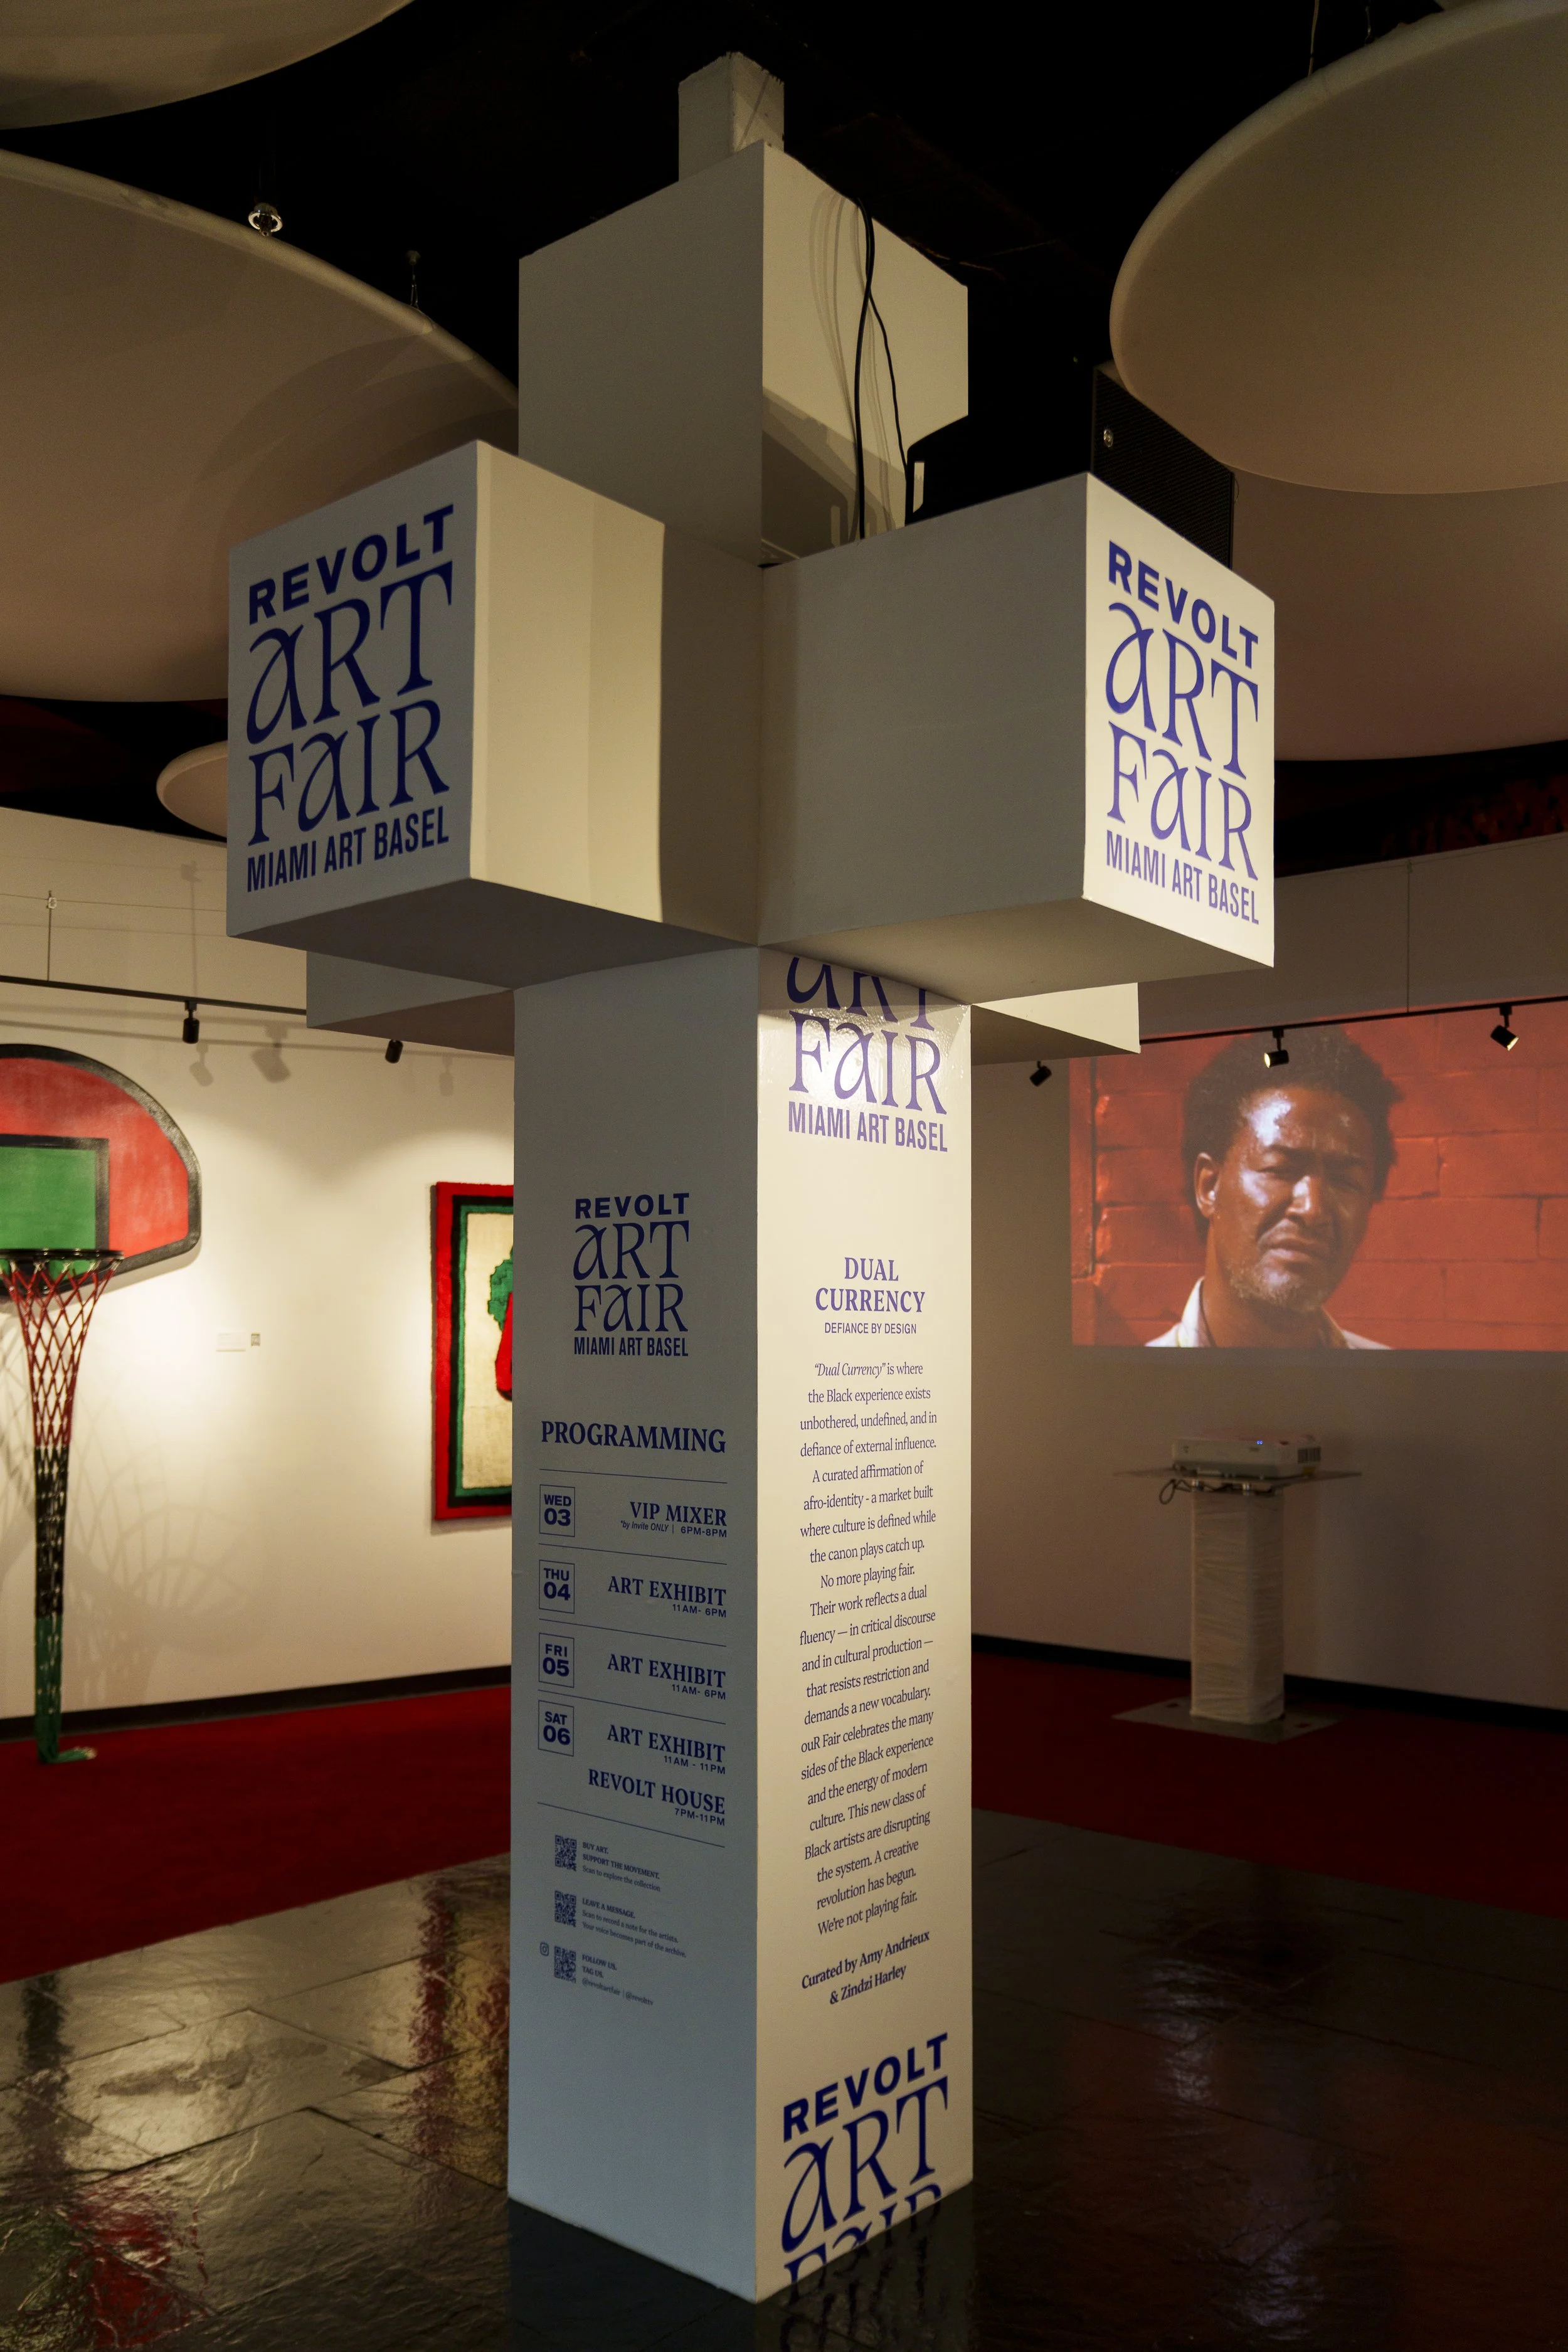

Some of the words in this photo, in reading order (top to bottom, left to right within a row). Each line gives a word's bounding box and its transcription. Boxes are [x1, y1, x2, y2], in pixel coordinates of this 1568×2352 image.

[250, 504, 453, 625] REVOLT
[1109, 540, 1258, 669] REVOLT
[247, 841, 316, 892] MIAMI
[325, 827, 366, 873] ART
[374, 805, 448, 861] BASEL
[1106, 830, 1165, 888] MIAMI
[1172, 862, 1202, 903] ART
[1209, 874, 1259, 924] BASEL
[788, 1101, 850, 1139] MIAMI
[857, 1111, 887, 1145] ART
[895, 1116, 947, 1152] BASEL
[575, 1193, 689, 1219] REVOLT
[844, 1257, 899, 1281] DUAL
[815, 1288, 925, 1312] CURRENCY
[825, 1322, 869, 1333] DEFIANCE
[871, 1323, 882, 1333] BY
[885, 1323, 916, 1334] DESIGN
[575, 1337, 614, 1355] MIAMI
[619, 1337, 643, 1355] ART
[647, 1337, 688, 1357] BASEL
[887, 1362, 894, 1375] is
[896, 1362, 923, 1374] where
[808, 1389, 824, 1403] the
[827, 1388, 852, 1402] Black
[855, 1388, 903, 1405] experience
[905, 1387, 931, 1399] exists
[800, 1414, 858, 1430] unbothered,
[861, 1412, 908, 1427] undefined,
[910, 1411, 926, 1424] and
[929, 1411, 937, 1423] in
[541, 1421, 726, 1453] PROGRAMMING
[800, 1442, 841, 1457] defiance
[844, 1439, 854, 1454] of
[856, 1438, 893, 1453] external
[895, 1436, 936, 1450] influence.
[812, 1470, 820, 1483] A
[822, 1466, 858, 1481] curated
[861, 1463, 912, 1478] affirmation
[914, 1460, 924, 1474] of
[544, 1495, 571, 1507] WED
[803, 1493, 864, 1510] afro-identity
[871, 1494, 877, 1503] a
[879, 1488, 911, 1502] market
[913, 1485, 933, 1499] built
[544, 1508, 571, 1526] 03
[630, 1502, 660, 1520] VIP
[665, 1505, 727, 1526] MIXER
[800, 1523, 830, 1537] where
[832, 1519, 866, 1534] culture
[868, 1517, 875, 1529] is
[877, 1512, 911, 1528] defined
[913, 1510, 936, 1523] while
[632, 1521, 649, 1530] Invite
[650, 1523, 669, 1532] ONLY
[681, 1526, 727, 1537] 6PM-8PM
[810, 1549, 826, 1563] the
[829, 1548, 858, 1560] canon
[860, 1542, 884, 1560] plays
[886, 1537, 909, 1553] catch
[912, 1540, 924, 1552] up.
[543, 1568, 569, 1581] THU
[821, 1575, 834, 1588] No
[837, 1574, 861, 1586] more
[864, 1567, 896, 1586] playing
[899, 1563, 914, 1576] fair.
[544, 1582, 571, 1601] 04
[608, 1576, 644, 1596] ART
[649, 1581, 726, 1606] EXHIBIT
[810, 1601, 836, 1616] Their
[838, 1596, 863, 1611] work
[866, 1592, 899, 1607] reflects
[901, 1592, 906, 1601] a
[908, 1584, 927, 1600] dual
[705, 1608, 726, 1618] 6PM
[800, 1630, 835, 1645] fluency
[850, 1623, 859, 1636] in
[861, 1616, 892, 1634] critical
[894, 1612, 936, 1628] discourse
[545, 1643, 567, 1657] FRI
[802, 1655, 820, 1672] and
[823, 1655, 832, 1668] in
[834, 1645, 870, 1665] cultural
[872, 1638, 922, 1661] production
[543, 1658, 569, 1677] 05
[608, 1654, 643, 1674] ART
[649, 1660, 726, 1688] EXHIBIT
[807, 1683, 827, 1698] that
[830, 1677, 861, 1693] resists
[863, 1666, 910, 1685] restriction
[913, 1659, 929, 1675] and
[704, 1690, 726, 1700] 6PM
[804, 1703, 849, 1725] demands
[851, 1705, 857, 1714] a
[859, 1699, 879, 1712] new
[881, 1687, 931, 1706] vocabulary.
[544, 1711, 568, 1725] SAT
[543, 1725, 571, 1746] 06
[607, 1725, 643, 1746] ART
[649, 1732, 725, 1762] EXHIBIT
[801, 1736, 820, 1752] ouR
[823, 1732, 841, 1747] Fair
[843, 1722, 889, 1742] celebrates
[891, 1716, 906, 1730] the
[909, 1712, 934, 1726] many
[664, 1756, 688, 1767] 11AM
[700, 1763, 725, 1774] 11PM
[802, 1762, 826, 1780] sides
[828, 1756, 839, 1772] of
[840, 1754, 856, 1769] the
[859, 1746, 884, 1764] Black
[886, 1737, 933, 1759] experience
[589, 1769, 655, 1798] REVOLT
[662, 1784, 724, 1814] HOUSE
[808, 1787, 826, 1805] and
[829, 1784, 844, 1799] the
[847, 1777, 879, 1794] energy
[881, 1769, 891, 1784] of
[892, 1762, 928, 1781] modern
[675, 1808, 724, 1826] 7PM-11PM
[810, 1813, 845, 1831] culture.
[848, 1803, 869, 1820] This
[871, 1799, 891, 1813] new
[893, 1792, 914, 1806] class
[916, 1784, 926, 1799] of
[583, 1842, 595, 1850] BUY
[595, 1845, 608, 1854] ART.
[583, 1853, 610, 1866] SUPPORT
[610, 1860, 623, 1870] THE
[623, 1864, 660, 1879] MOVEMENT.
[582, 1898, 600, 1909] LEAVE
[607, 1905, 635, 1919] MESSAGE.
[802, 1961, 842, 1989] Curated
[845, 1959, 857, 1973] by
[860, 1949, 883, 1967] Amy
[885, 1931, 930, 1957] Andrieux
[830, 1991, 839, 2005] &
[841, 1975, 872, 2001] Zindzi
[875, 1966, 906, 1987] Harley
[784, 2032, 948, 2143] REVOLT
